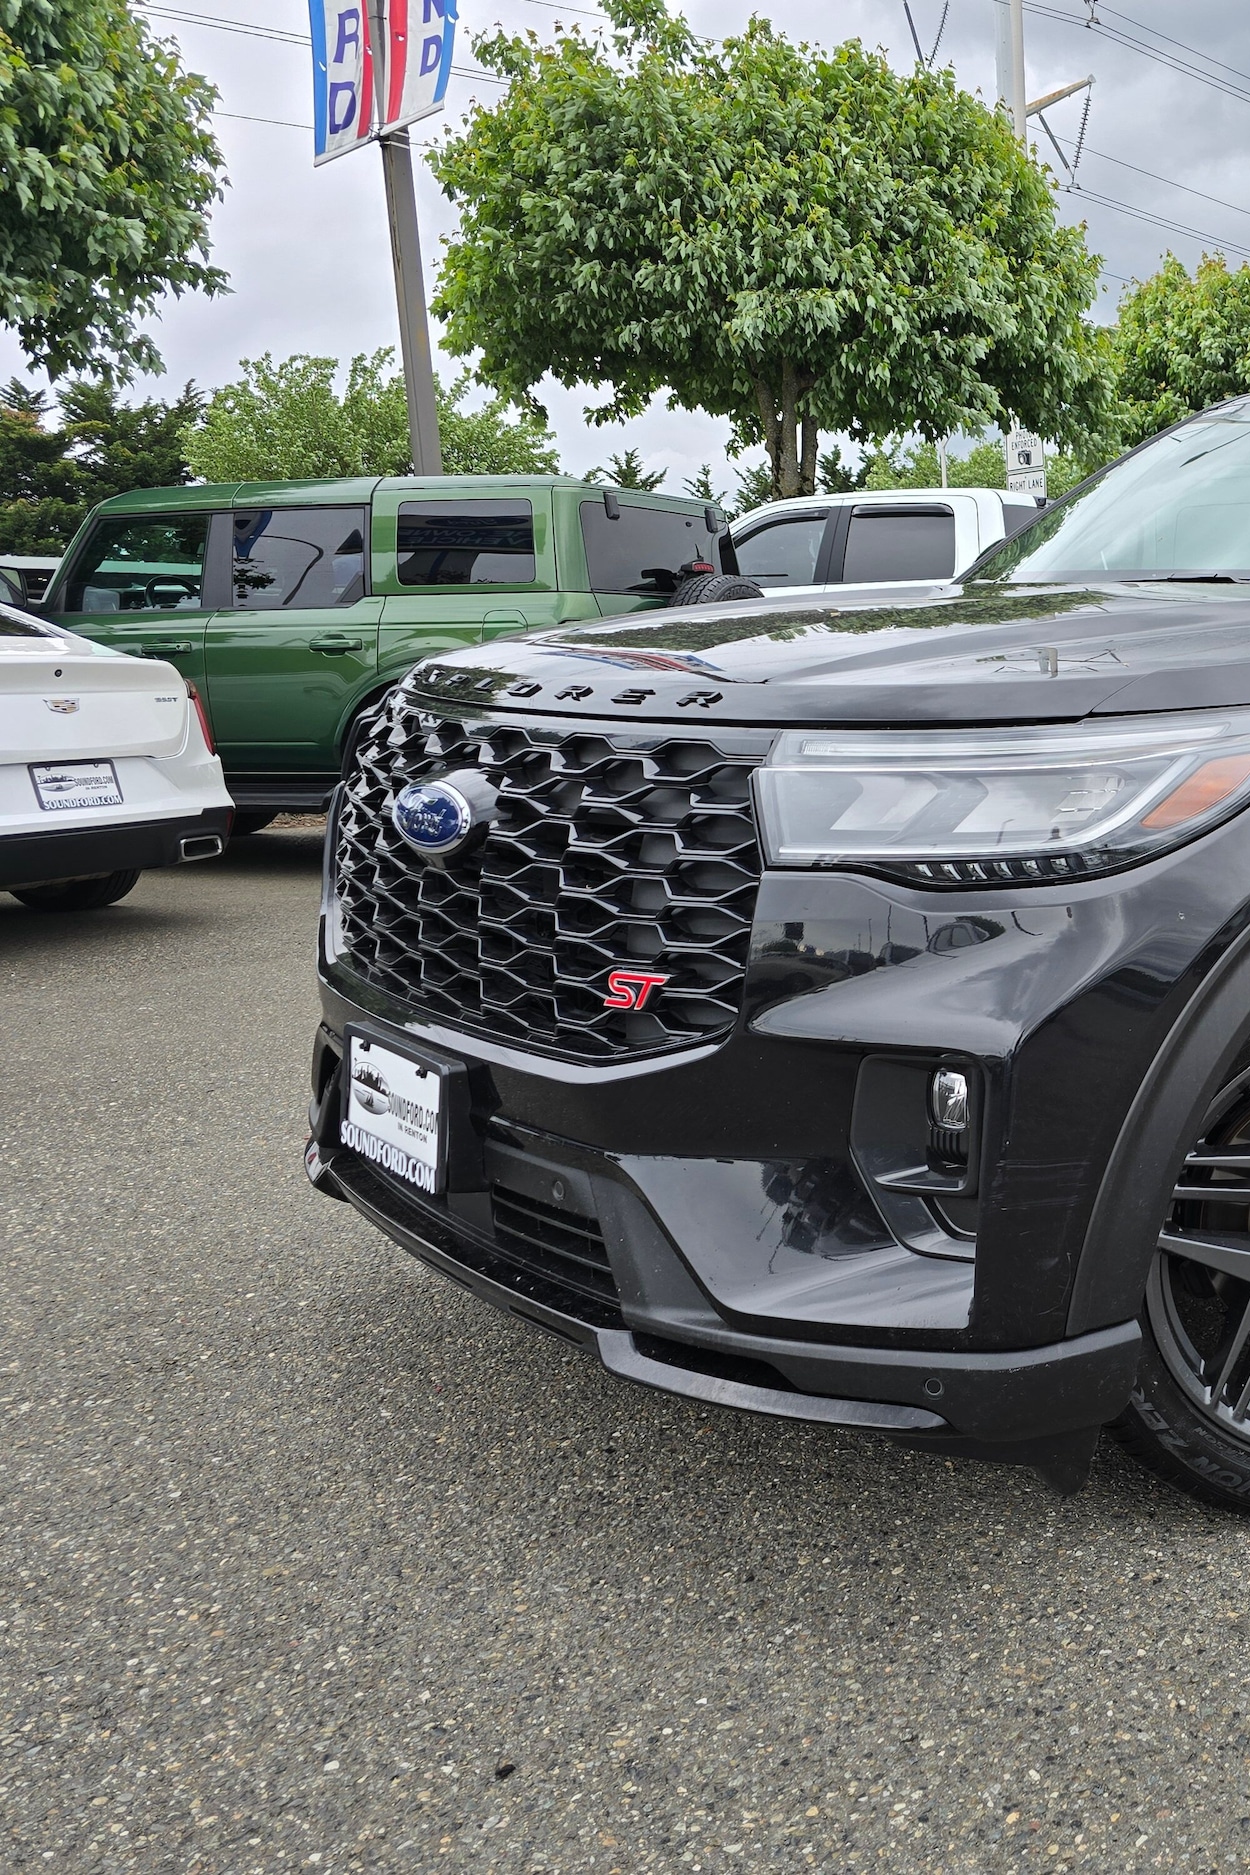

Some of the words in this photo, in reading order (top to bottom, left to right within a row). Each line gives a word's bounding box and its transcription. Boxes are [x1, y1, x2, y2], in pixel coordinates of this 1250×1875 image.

[1011, 438, 1037, 450] ENFORCED
[1010, 480, 1026, 492] RIGHT
[1028, 478, 1043, 489] LANE
[44, 795, 122, 810] SOUNDFORD.COM
[603, 969, 671, 1010] ST
[404, 1125, 428, 1143] RENTON
[340, 1120, 437, 1194] SOUNDFORD.COM
